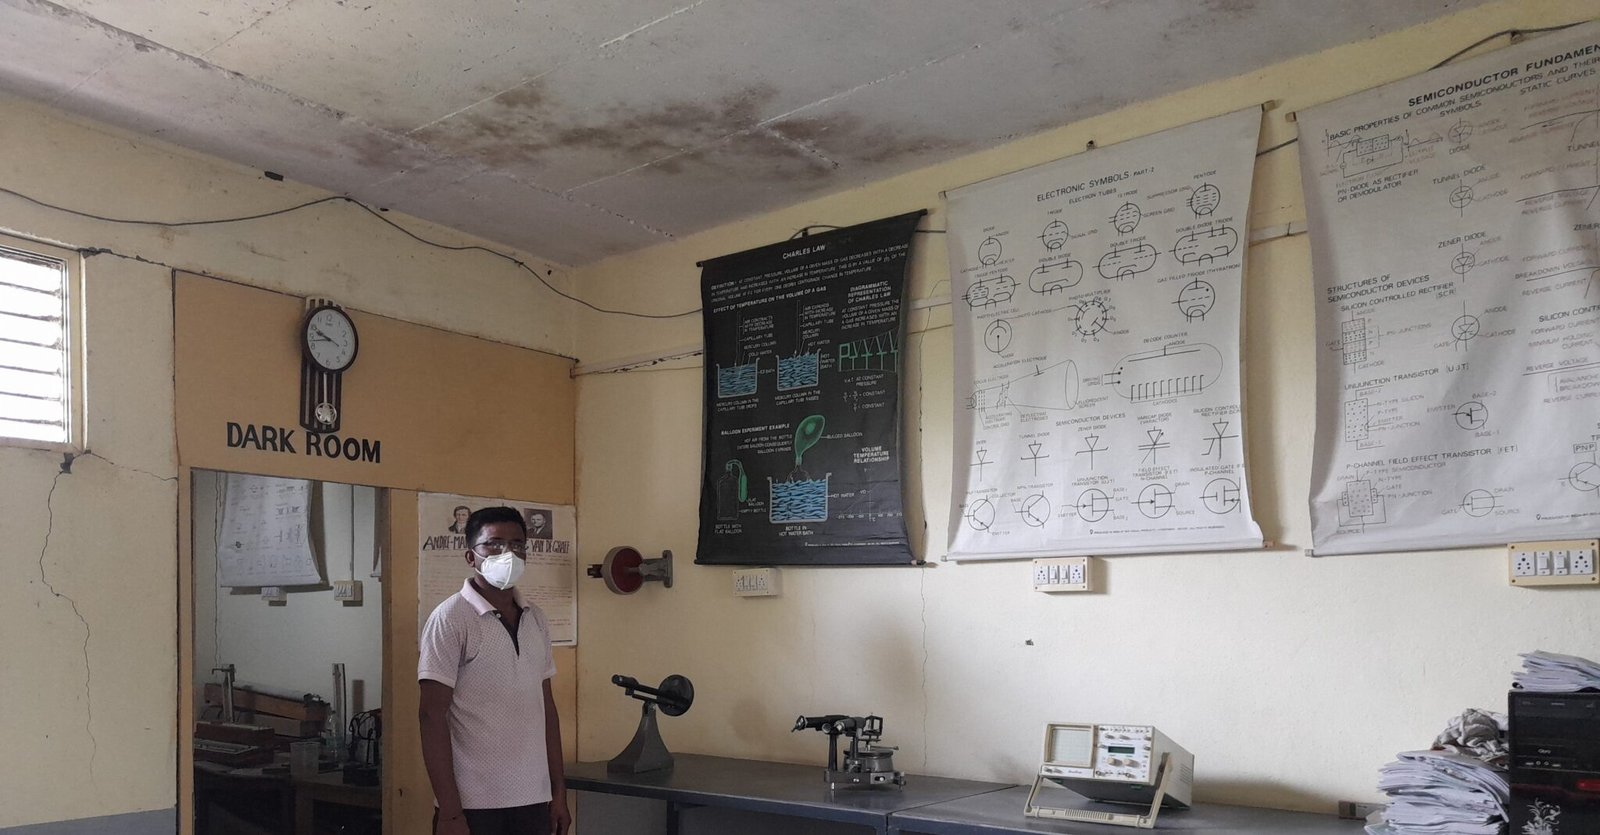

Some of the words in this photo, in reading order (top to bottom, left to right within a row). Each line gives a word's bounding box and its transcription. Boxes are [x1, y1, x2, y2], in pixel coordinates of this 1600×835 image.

[1408, 67, 1518, 106] SEMICONDUCTOR
[1526, 43, 1600, 72] FUNDAMEN
[1520, 80, 1552, 95] STATIC
[1556, 69, 1596, 84] CURVES
[1330, 128, 1351, 141] BASIC
[1354, 115, 1400, 133] PROPERTIES
[1416, 98, 1455, 116] COMMON
[1460, 72, 1543, 102] SEMICONDUCTORS
[1547, 66, 1568, 77] AND
[1572, 57, 1600, 67] THEIR
[1440, 101, 1482, 117] SYMBOLS
[1448, 144, 1470, 154] DIODE
[1193, 170, 1216, 180] PENTODE
[1384, 169, 1418, 182] RECTIFIER
[1433, 174, 1460, 184] TUNNEL
[1463, 165, 1486, 176] DIODE
[1037, 182, 1086, 202] ELECTRONIC
[1088, 171, 1130, 188] SYMBOLS
[1348, 181, 1402, 200] DEMODULATOR
[1069, 190, 1096, 204] ELECTRON
[1098, 188, 1118, 198] TUBES
[1176, 224, 1195, 233] DOUBLE
[1197, 220, 1213, 228] DIODE
[1215, 216, 1233, 224] TRIODE
[1573, 222, 1600, 232] ZENER
[1130, 236, 1146, 244] TRIODE
[1438, 236, 1462, 248] ZENER
[1464, 231, 1486, 242] DIODE
[782, 248, 810, 260] CHARLES
[812, 245, 826, 253] LAW
[848, 252, 873, 260] DECREASES
[1515, 265, 1560, 278] BREAKDOWN
[850, 280, 888, 292] DIAGRAMMATIC
[1327, 278, 1378, 295] STRUCTURES
[1380, 274, 1390, 282] OF
[1328, 283, 1394, 303] SEMICONDUCTOR
[1396, 274, 1430, 288] DEVICES
[1522, 286, 1552, 296] REVERSE
[1555, 278, 1587, 289] CURRENT
[848, 286, 892, 298] REPRESENTATION
[855, 294, 878, 302] CHARLES
[1341, 302, 1368, 312] SILICON
[1370, 291, 1416, 306] CONTROLLED
[1418, 282, 1454, 294] RECTIFIER
[713, 306, 730, 314] EFFECT
[736, 298, 768, 310] TEMPERATURE
[786, 290, 804, 300] VOLUME
[848, 304, 868, 312] CONSTANT
[1484, 306, 1508, 314] ANODE
[1539, 311, 1570, 322] SILICON
[342, 330, 347, 338] 2
[1486, 328, 1516, 338] CATHODE
[1532, 324, 1566, 334] FORWARD
[1164, 332, 1188, 340] COUNTER
[1528, 337, 1560, 347] MINIMUM
[1562, 340, 1592, 350] CURRENT
[1358, 360, 1384, 370] CATHODE
[1526, 362, 1554, 372] REVERSE
[1558, 358, 1588, 366] VOLTAGE
[1394, 368, 1439, 382] TRANSISTOR
[1056, 416, 1100, 427] SEMICONDUCTOR
[742, 425, 768, 434] EXPERIMENT
[227, 422, 296, 454] DARK
[306, 431, 380, 464] ROOM
[854, 450, 889, 458] TEMPERATURE
[854, 456, 890, 464] RELATIONSHIP
[1346, 460, 1384, 470] P-CHANNEL
[1388, 456, 1408, 466] FIELD
[1411, 454, 1438, 463] EFFECT
[1442, 448, 1492, 460] TRANSISTOR
[1392, 462, 1446, 472] SEMICONDUCTOR
